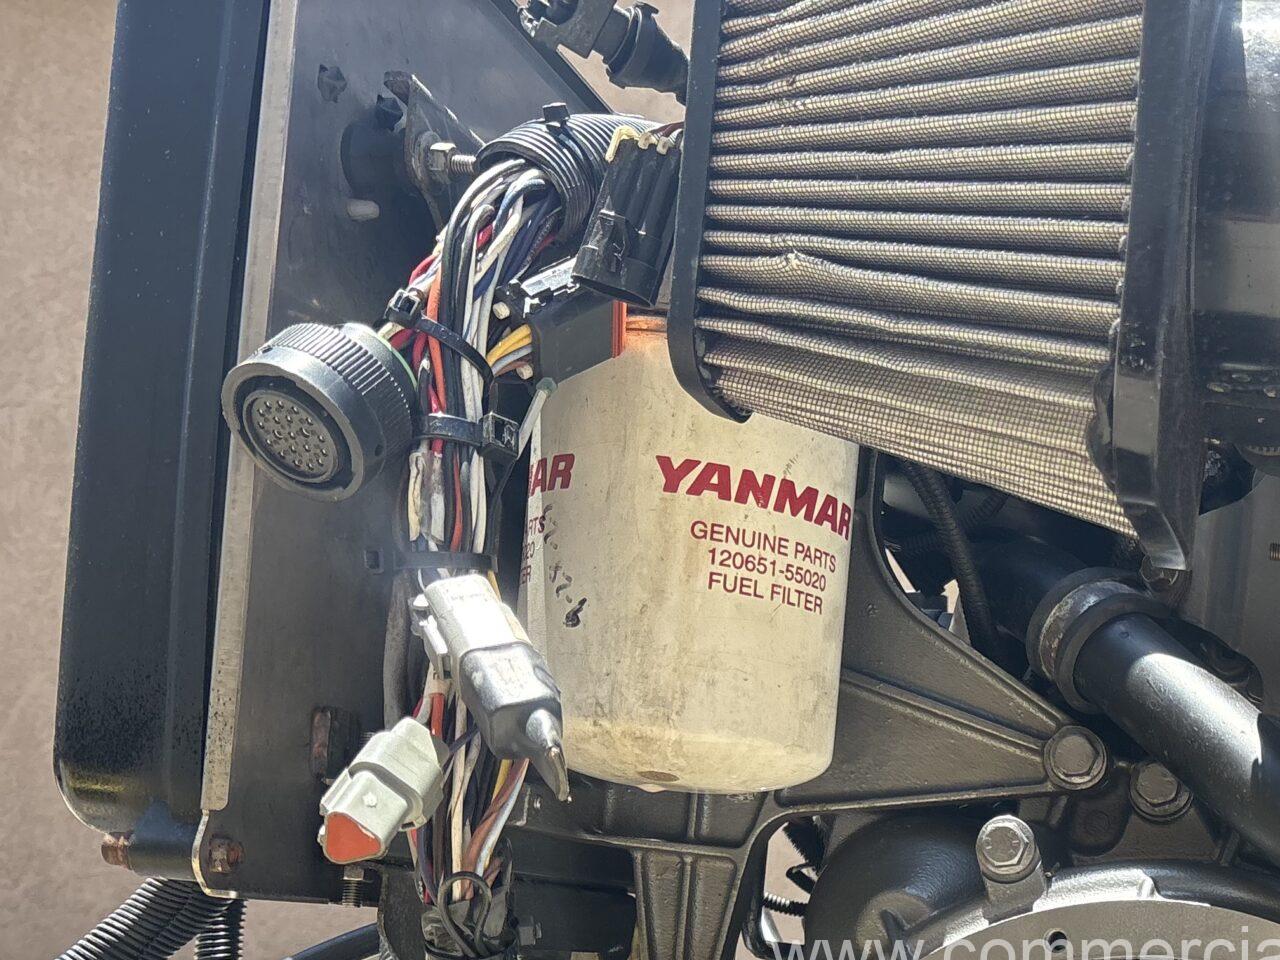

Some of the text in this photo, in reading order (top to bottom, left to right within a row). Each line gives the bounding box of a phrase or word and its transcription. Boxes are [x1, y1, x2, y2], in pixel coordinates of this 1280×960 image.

[528, 453, 575, 496] AR
[655, 455, 852, 540] YANMAR
[690, 520, 837, 573] GENUINE PARTS
[707, 548, 827, 592] 120651-55020
[707, 571, 823, 615] FUEL FILTER
